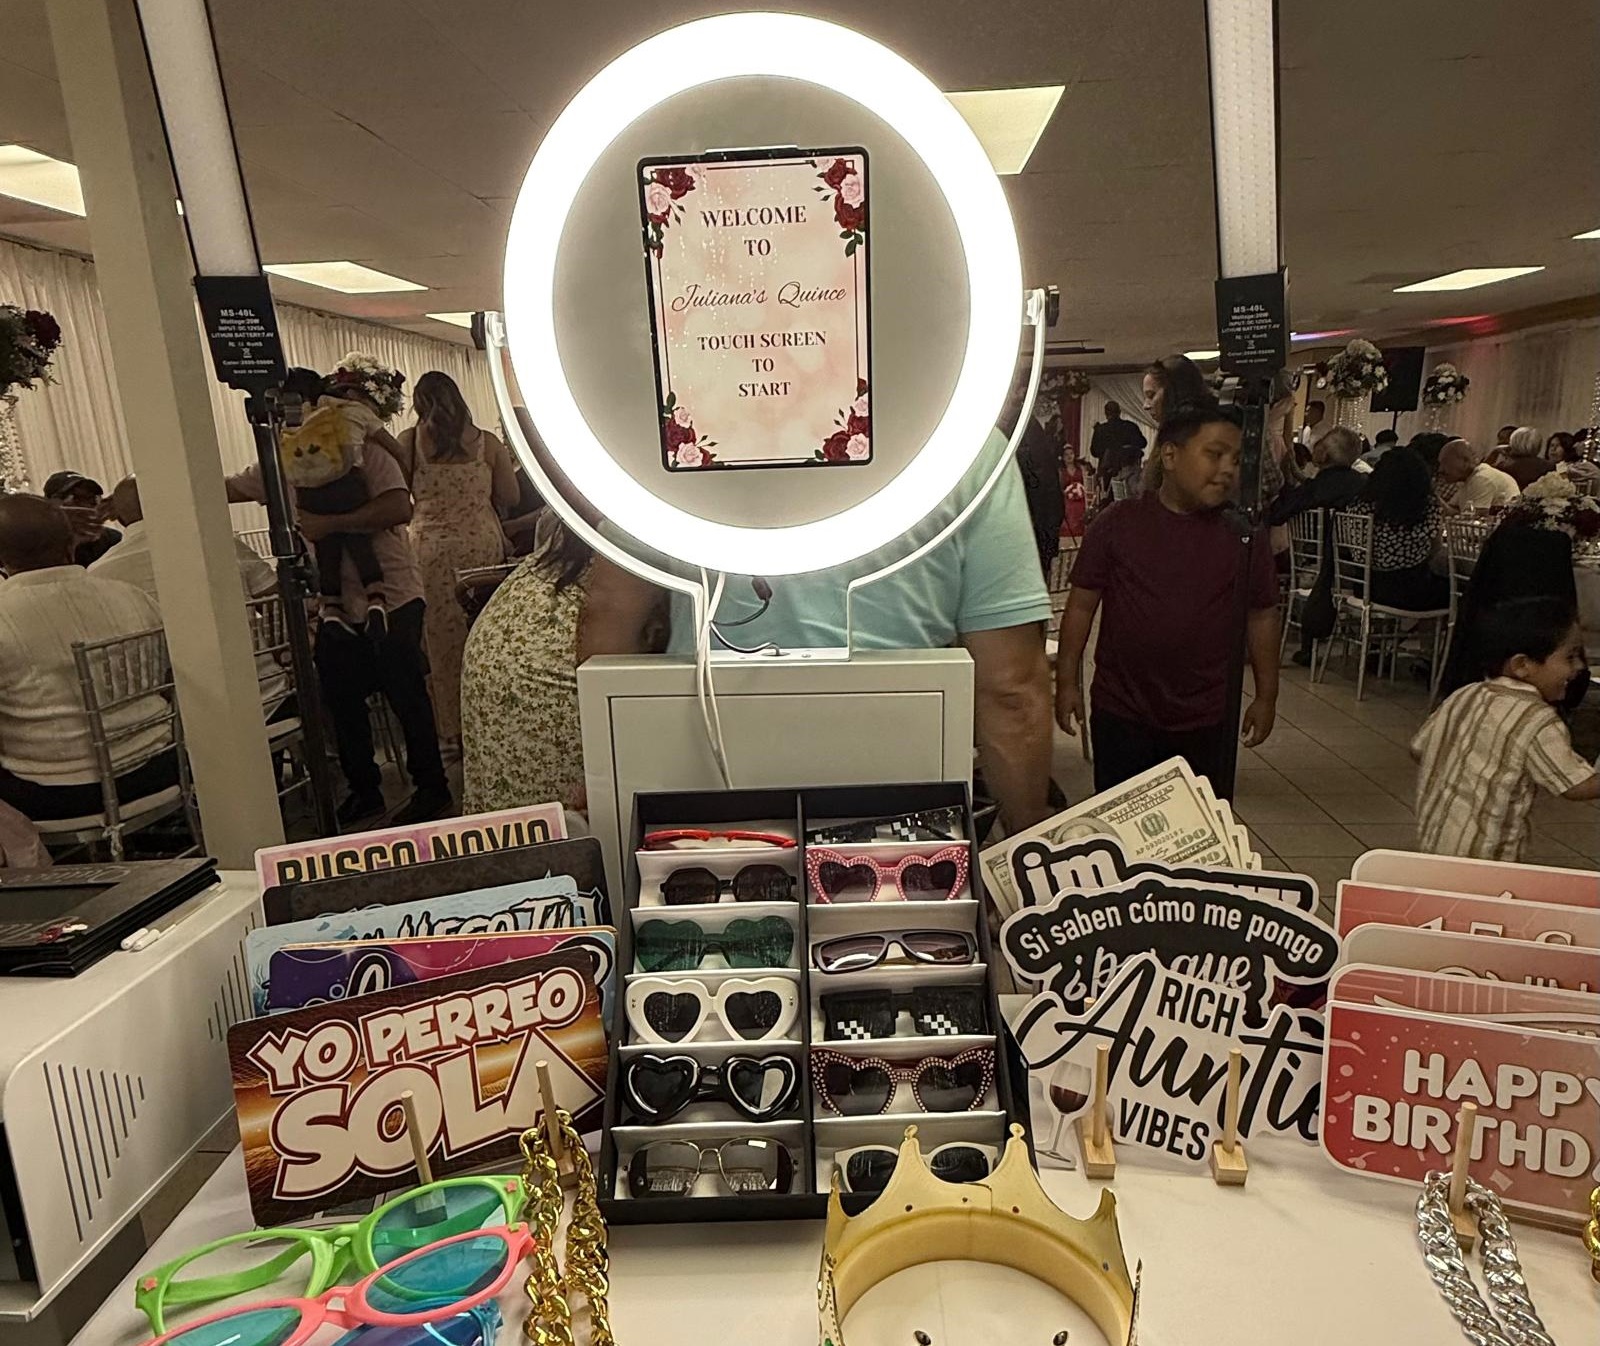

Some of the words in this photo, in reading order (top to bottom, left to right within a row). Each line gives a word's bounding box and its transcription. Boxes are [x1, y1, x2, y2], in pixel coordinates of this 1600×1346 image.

[701, 206, 807, 228] WELCOME
[744, 239, 771, 256] TO
[671, 284, 768, 312] Juliana's
[777, 281, 847, 308] Quince
[697, 334, 755, 350] TOUCH
[760, 331, 826, 348] SCREEN
[752, 358, 774, 372] TO
[738, 382, 791, 397] START
[1172, 827, 1207, 850] 100
[1019, 926, 1050, 961] Si
[1050, 903, 1122, 946] saben
[1128, 893, 1196, 923] cómo
[1202, 902, 1242, 932] me
[1244, 914, 1325, 964] pongo
[1156, 976, 1241, 1037] RICH
[260, 1019, 354, 1085] YO
[368, 970, 580, 1063] PERREO
[274, 1031, 600, 1194] SOLA
[1119, 1097, 1210, 1160] VIBES
[1352, 1094, 1600, 1184] BIRTHD
